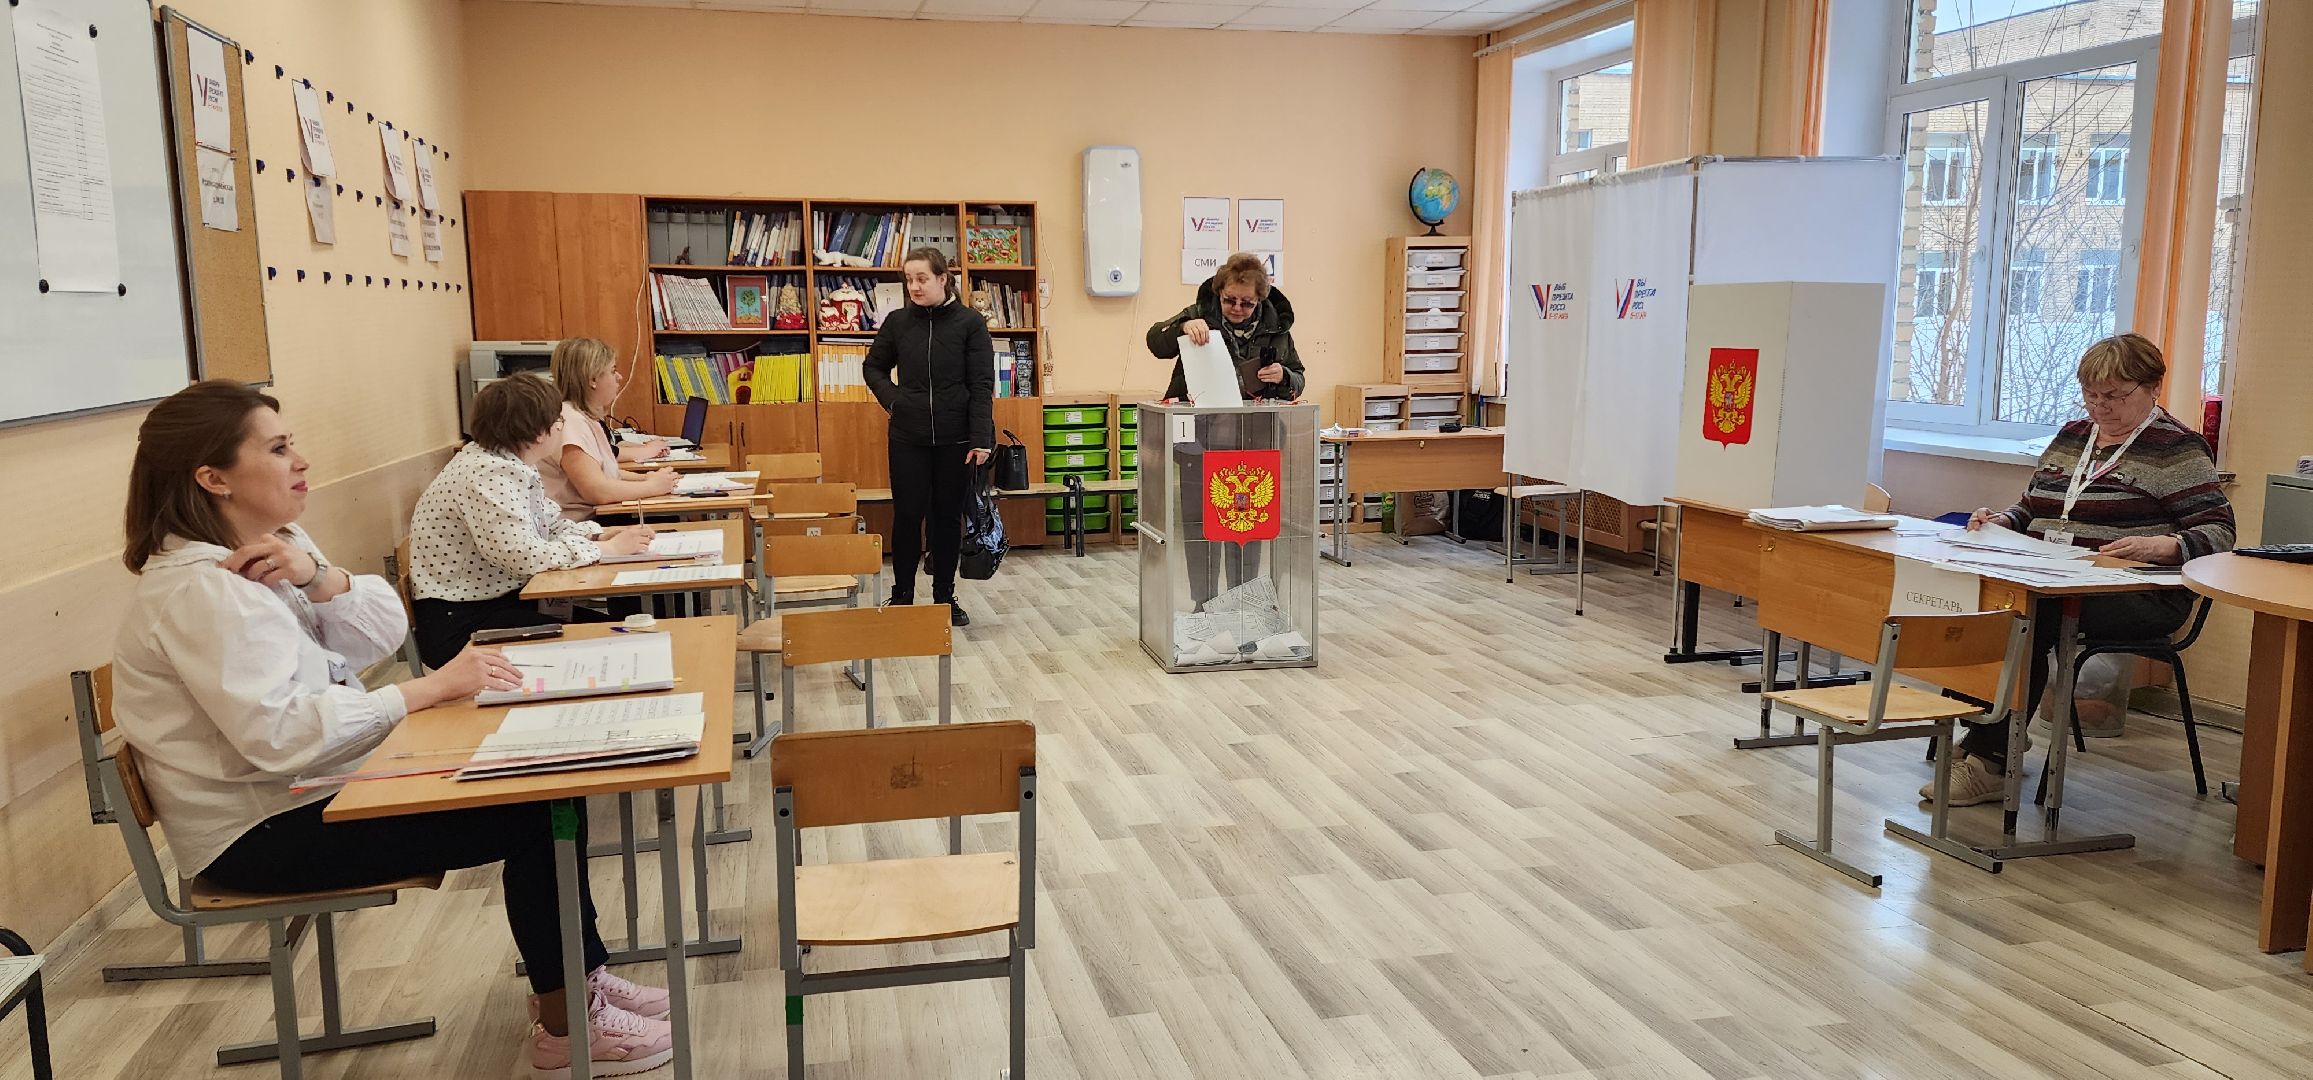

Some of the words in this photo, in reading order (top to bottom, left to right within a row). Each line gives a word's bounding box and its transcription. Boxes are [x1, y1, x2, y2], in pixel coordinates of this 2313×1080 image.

[1194, 258, 1217, 267] СМИ
[1181, 421, 1186, 438] 1
[1906, 591, 1963, 613] СЕКРЕТАРЬ
